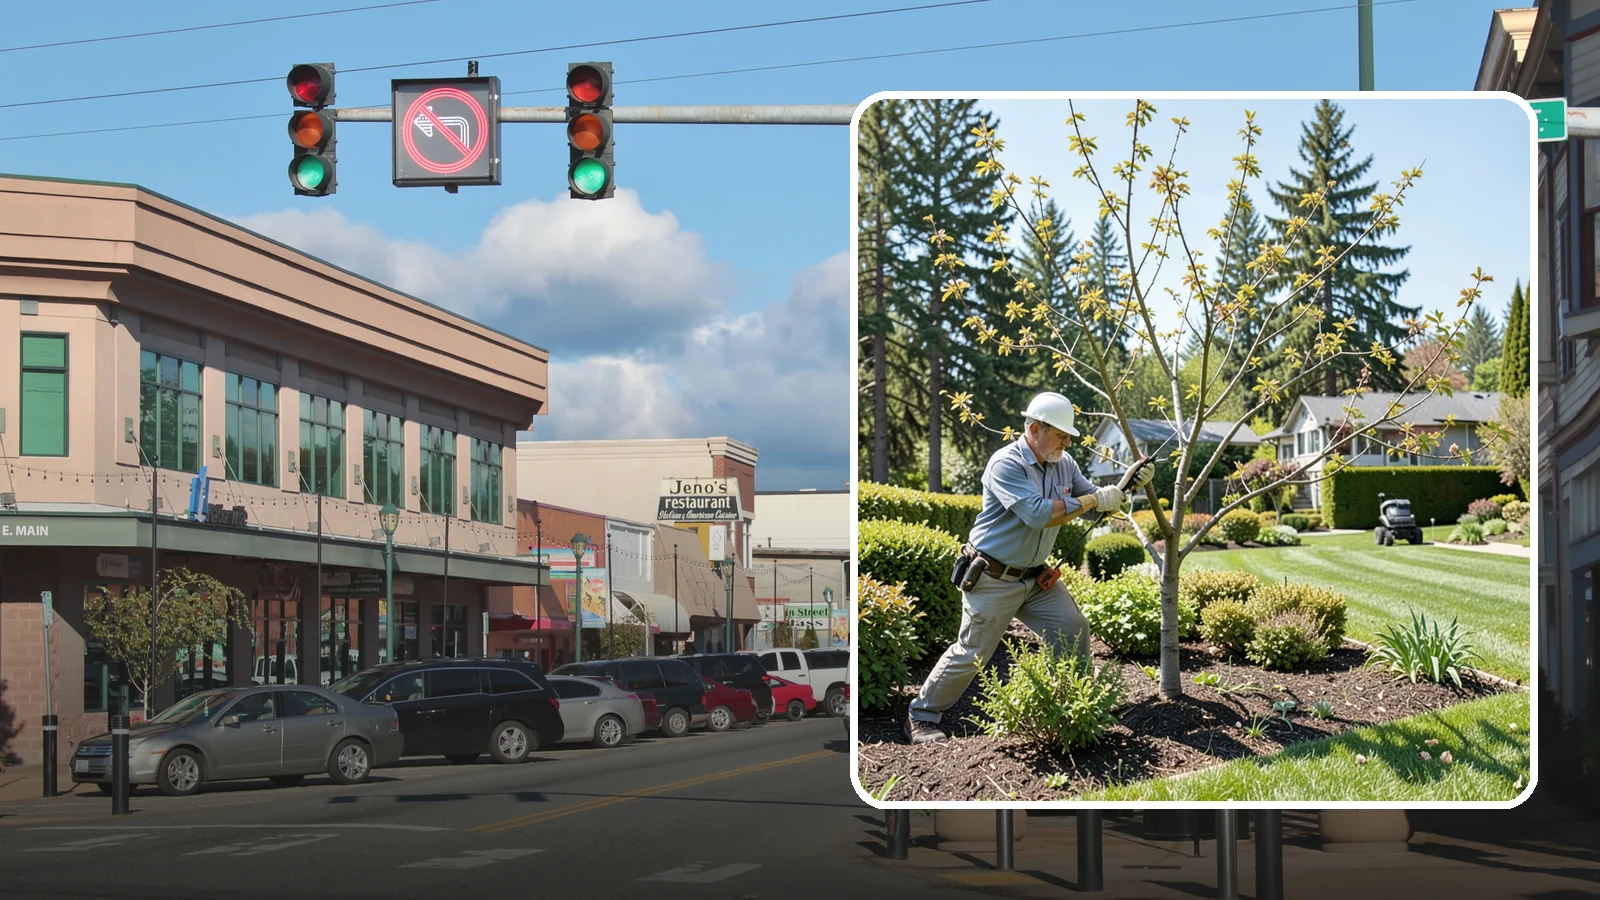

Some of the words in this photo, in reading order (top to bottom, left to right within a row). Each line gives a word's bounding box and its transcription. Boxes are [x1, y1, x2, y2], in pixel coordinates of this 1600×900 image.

[669, 480, 727, 495] Jeno's
[665, 496, 731, 509] restaurant
[658, 509, 681, 520] Italian
[686, 509, 715, 519] American
[715, 509, 737, 519] Cuisine
[2, 525, 13, 536] E.
[15, 525, 49, 536] MAIN
[797, 607, 828, 616] Street
